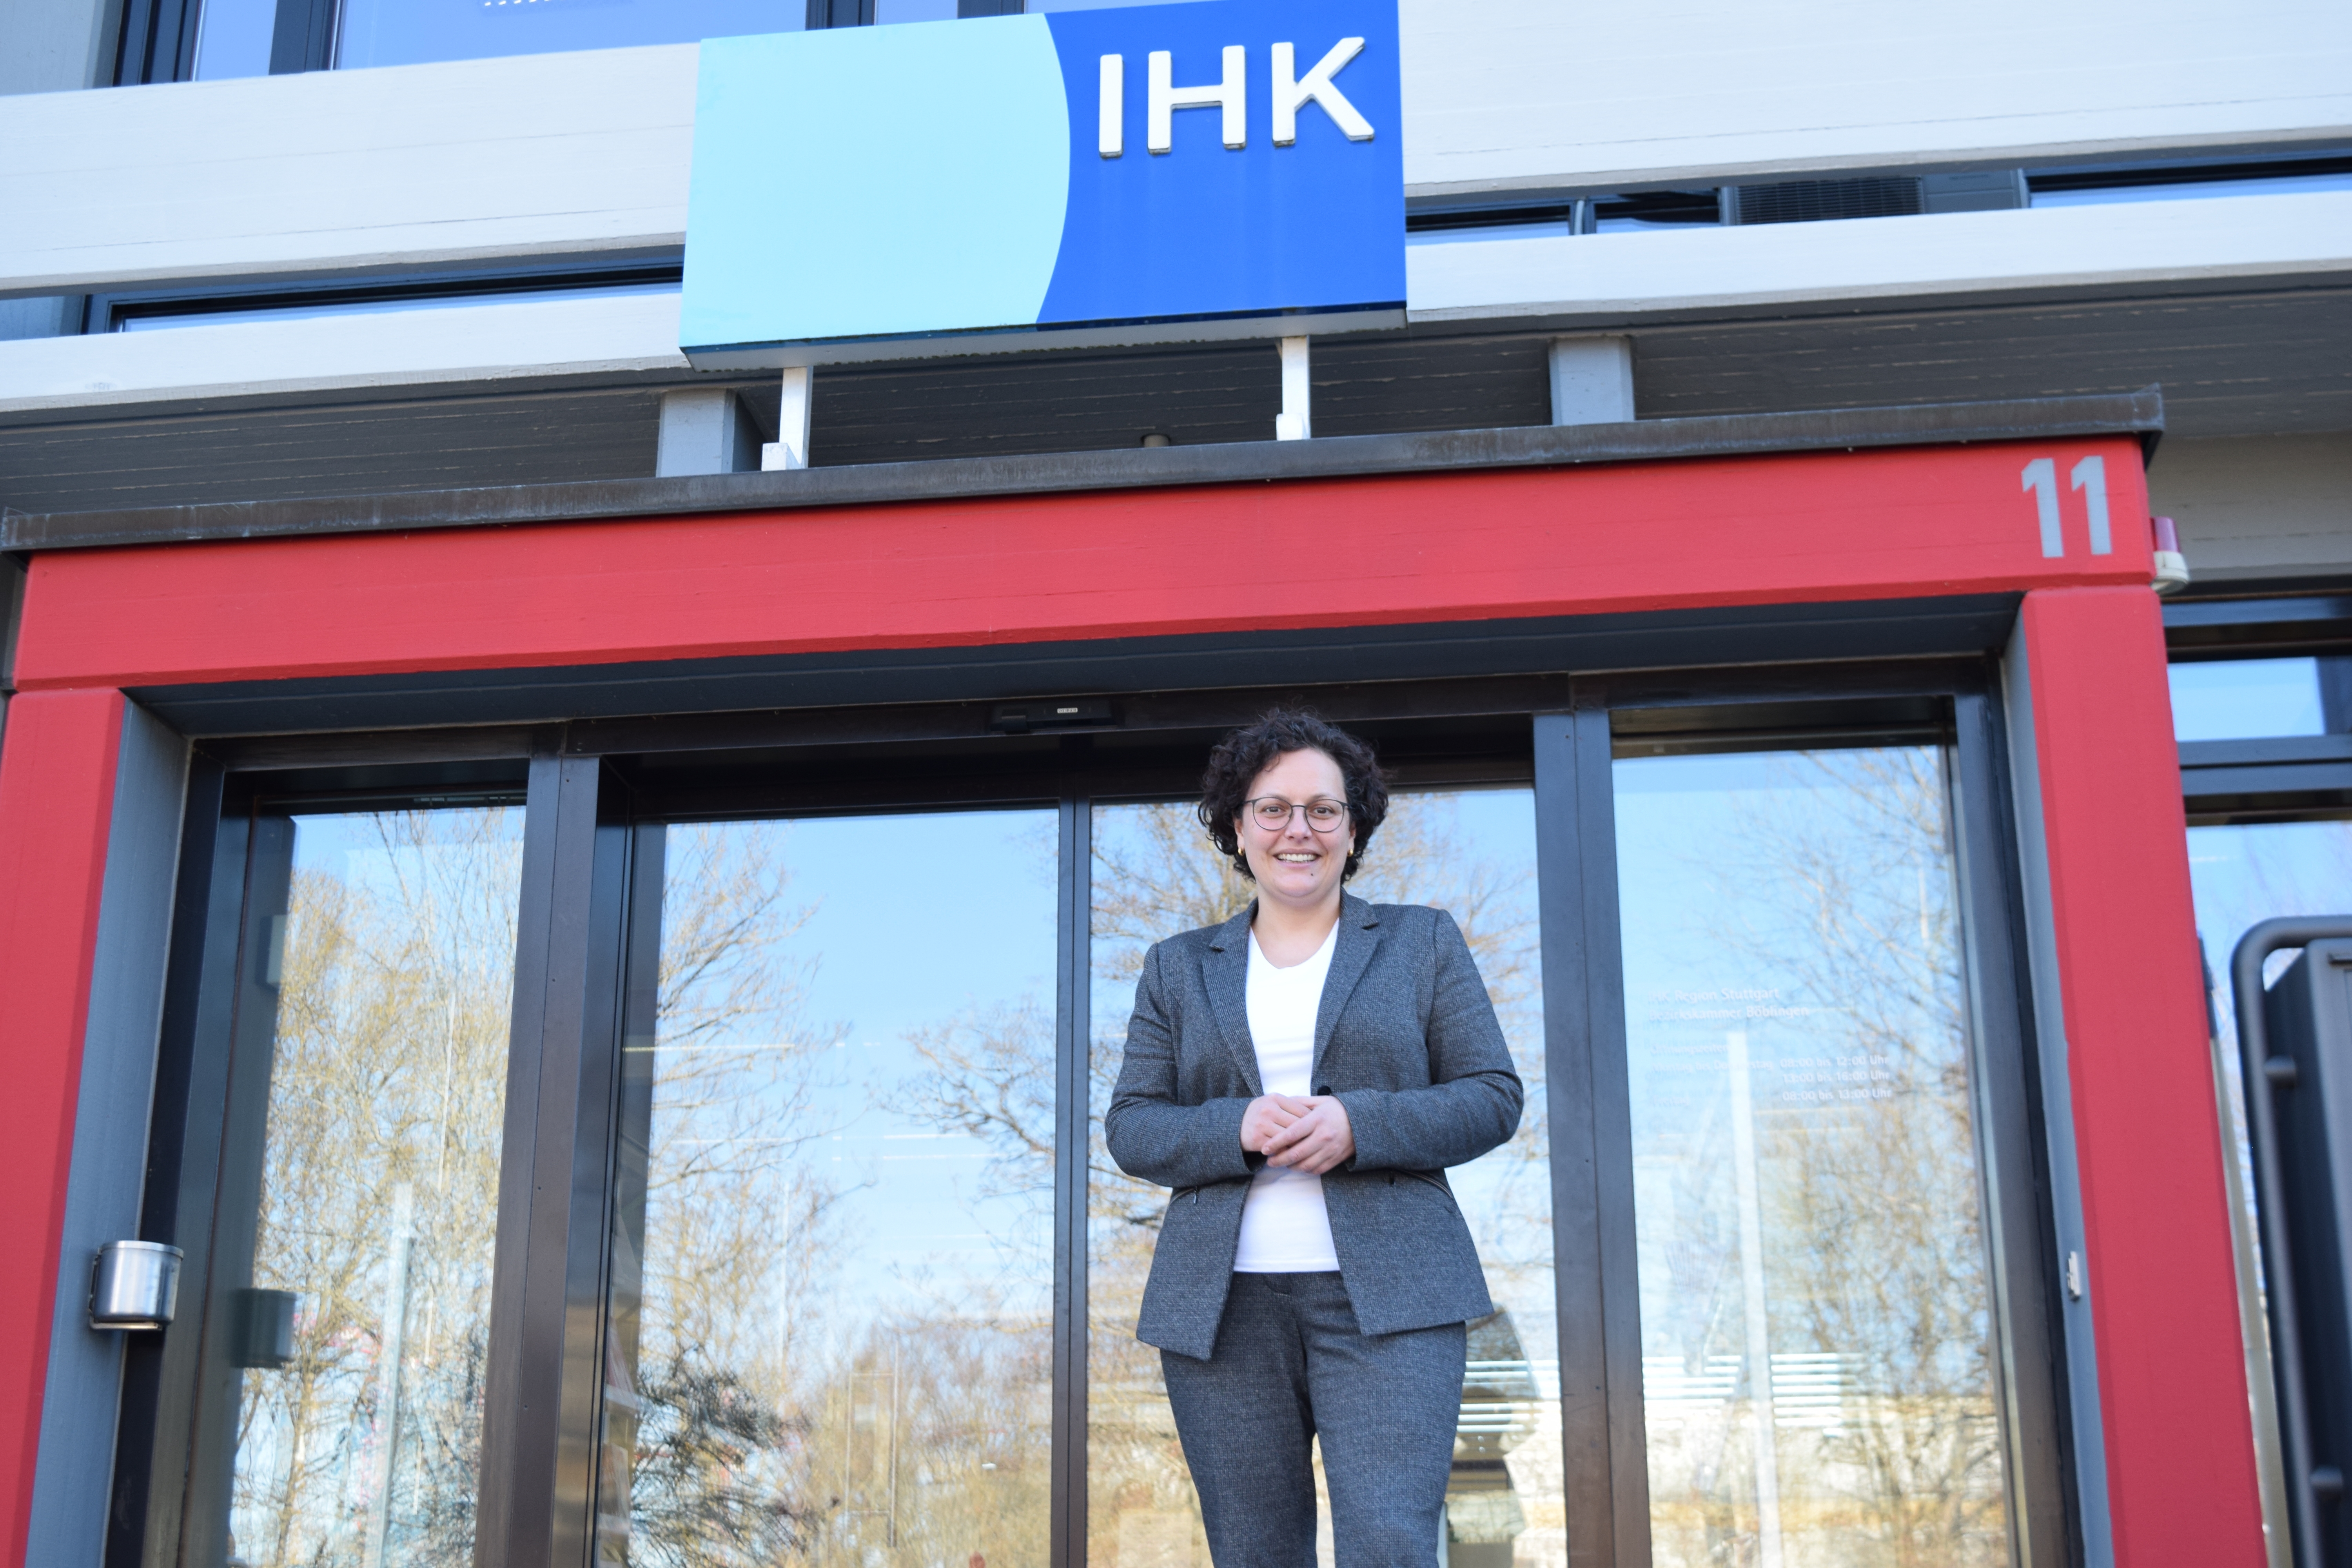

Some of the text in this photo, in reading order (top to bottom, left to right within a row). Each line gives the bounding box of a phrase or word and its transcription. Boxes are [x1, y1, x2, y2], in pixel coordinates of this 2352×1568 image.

[1099, 36, 1375, 158] IHK
[2021, 455, 2112, 558] 11
[1648, 987, 1780, 1004] IHK Region Stuttgart
[1649, 1005, 1810, 1020] Bezirkskammer Böblingen
[1695, 1060, 1710, 1071] bis
[1780, 1058, 1813, 1068] 08:00
[1816, 1057, 1831, 1066] bis
[1836, 1056, 1866, 1066] 12:00
[1869, 1054, 1889, 1065] Uhr
[1782, 1070, 1889, 1083] 13:00 bis 16:00 Uhr
[1782, 1091, 1816, 1101] 08:00
[1818, 1090, 1834, 1100] bis
[1838, 1089, 1869, 1099] 13:00
[1872, 1088, 1892, 1098] Uhr
